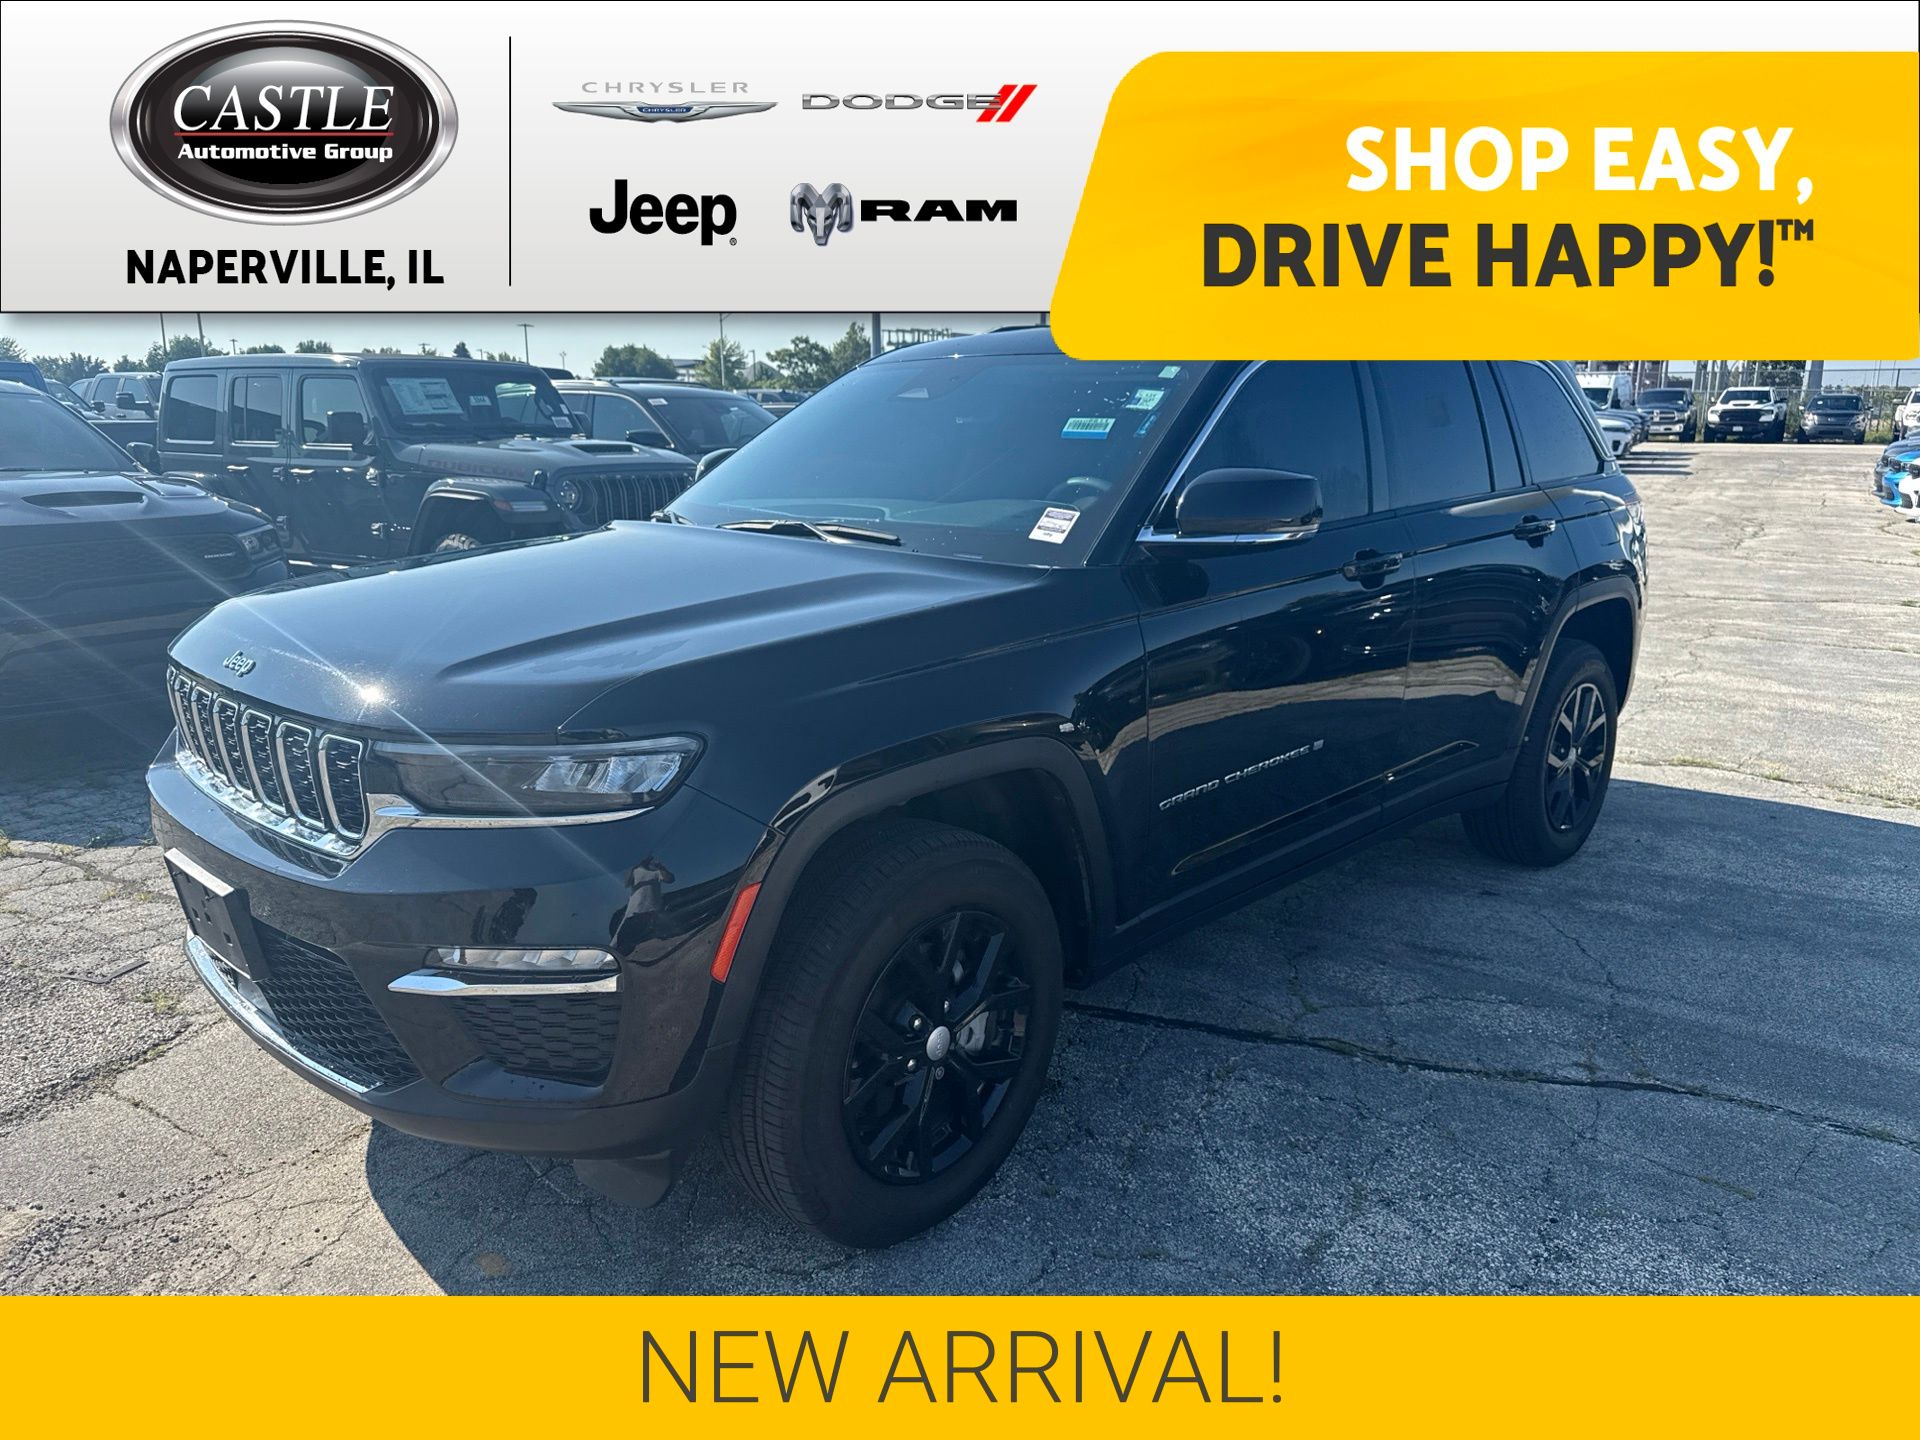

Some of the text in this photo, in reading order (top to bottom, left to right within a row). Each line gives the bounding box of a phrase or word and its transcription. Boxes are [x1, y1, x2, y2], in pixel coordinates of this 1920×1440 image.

[222, 649, 256, 678] Jeep
[1159, 745, 1310, 811] GRAND CHEROKEE
